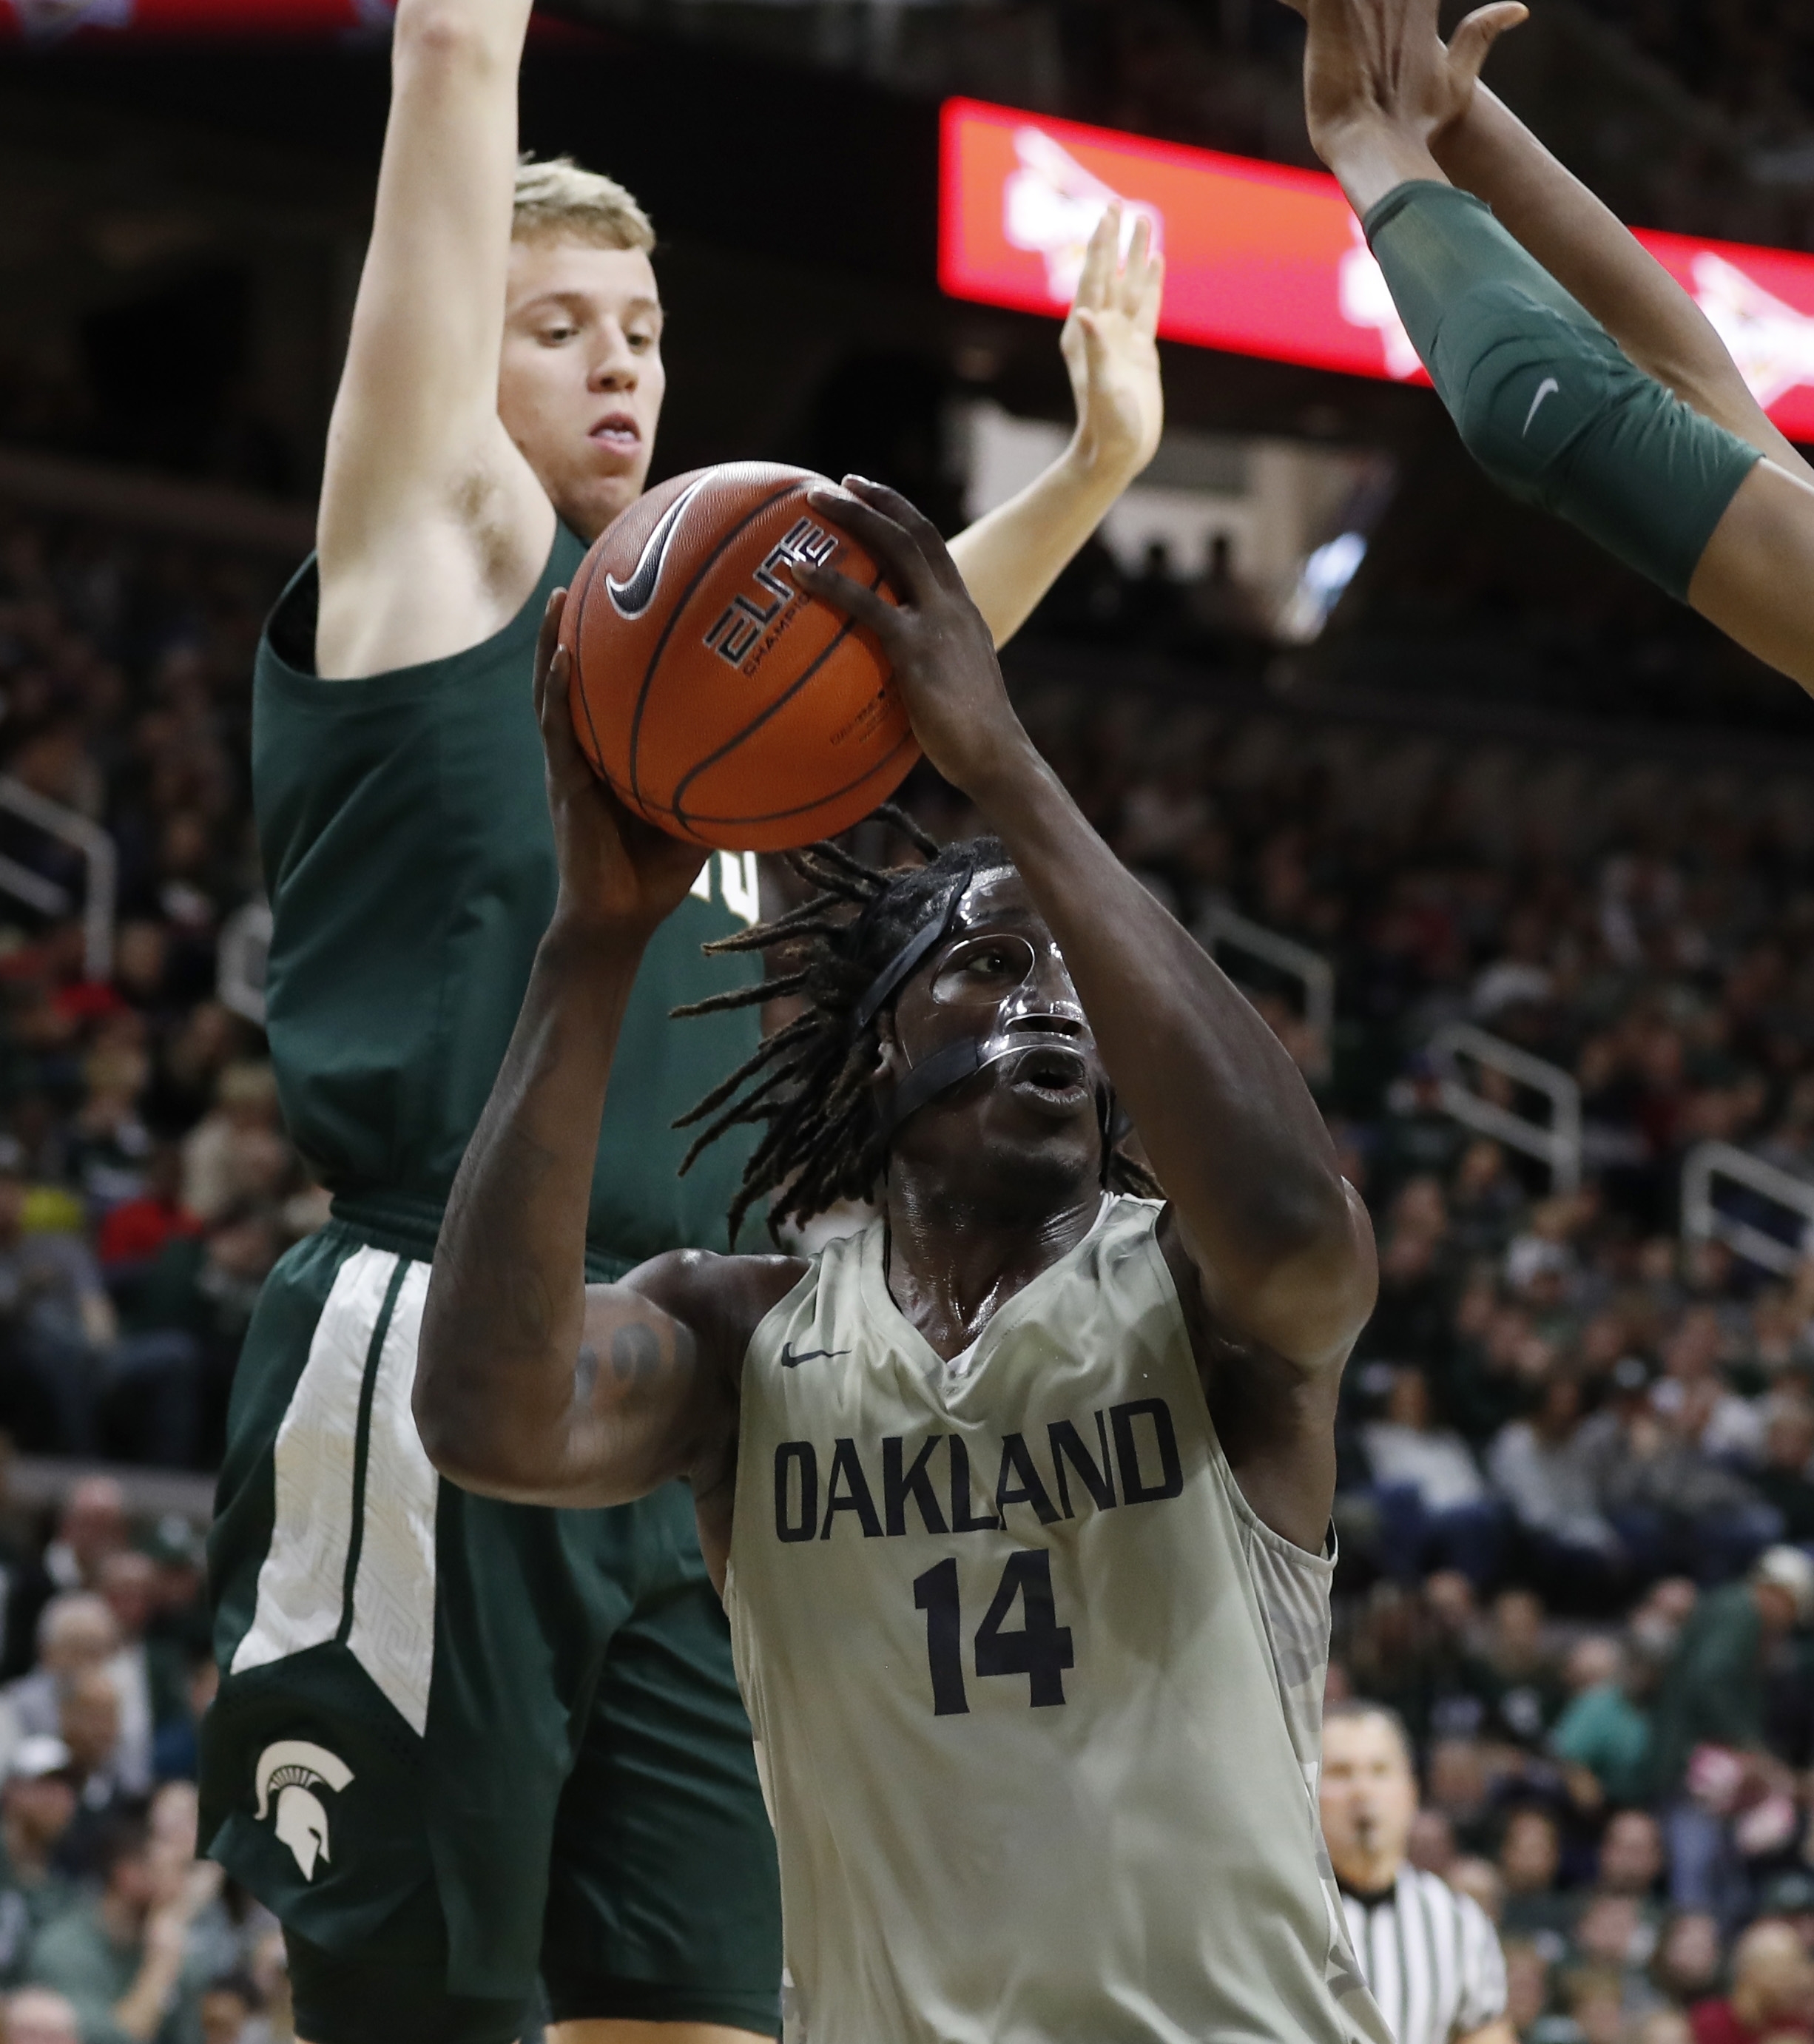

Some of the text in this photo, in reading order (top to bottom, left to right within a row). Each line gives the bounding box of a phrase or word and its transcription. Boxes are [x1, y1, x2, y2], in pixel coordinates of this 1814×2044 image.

[703, 516, 839, 669] ELITE
[743, 592, 812, 678] CHAMPIO
[775, 1397, 1184, 1543] OAKLAND
[913, 1548, 1074, 1716] 14
